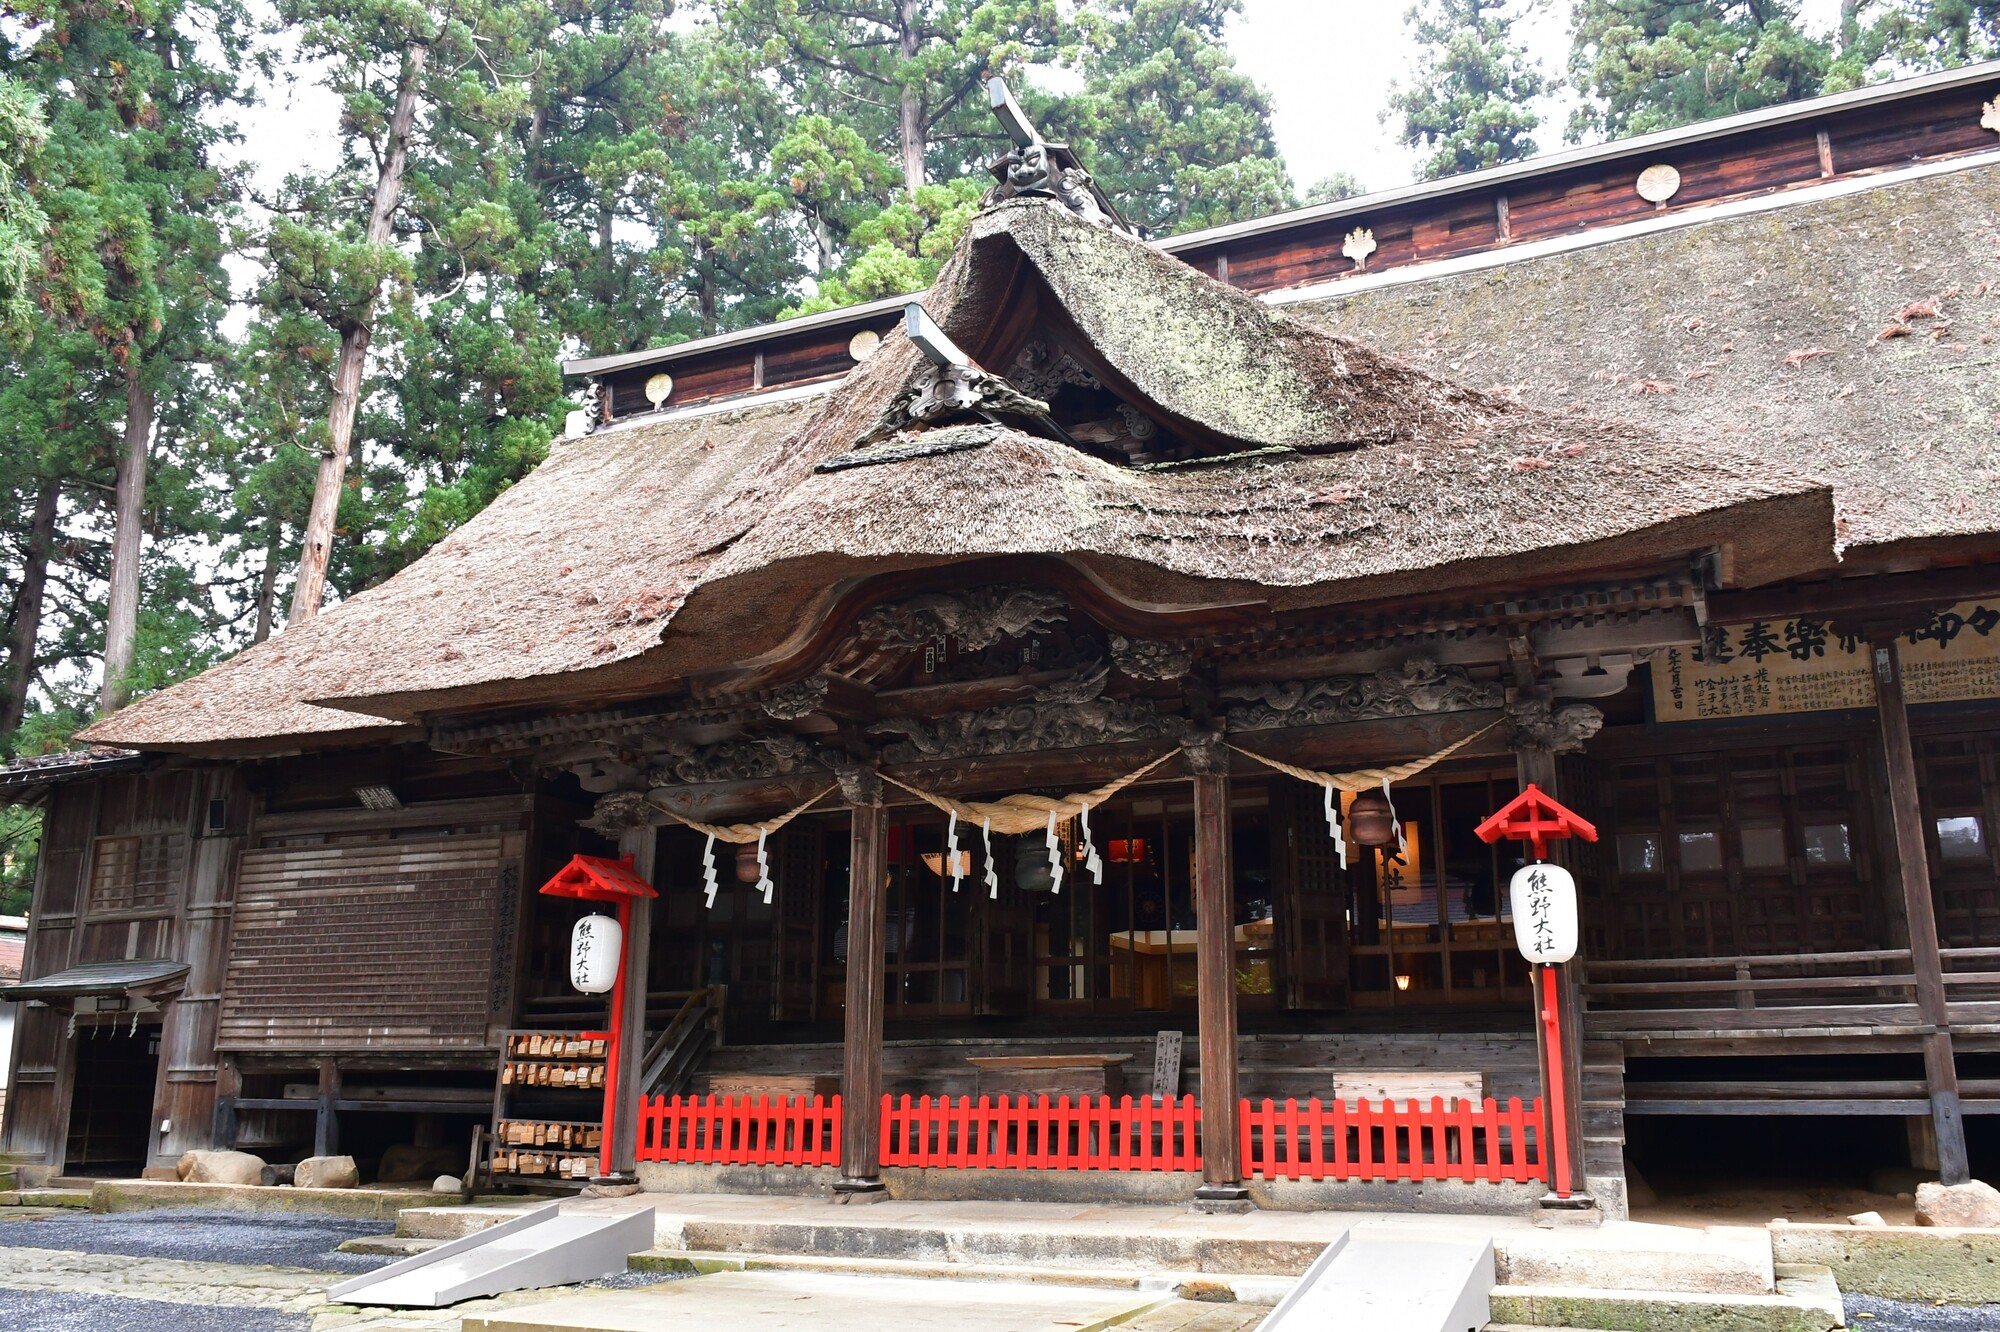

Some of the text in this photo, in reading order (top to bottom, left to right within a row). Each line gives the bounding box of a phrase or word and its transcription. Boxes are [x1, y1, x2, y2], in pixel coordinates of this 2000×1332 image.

[1527, 869, 1556, 955] 熊野大社
[575, 920, 595, 986] 熊野大社
